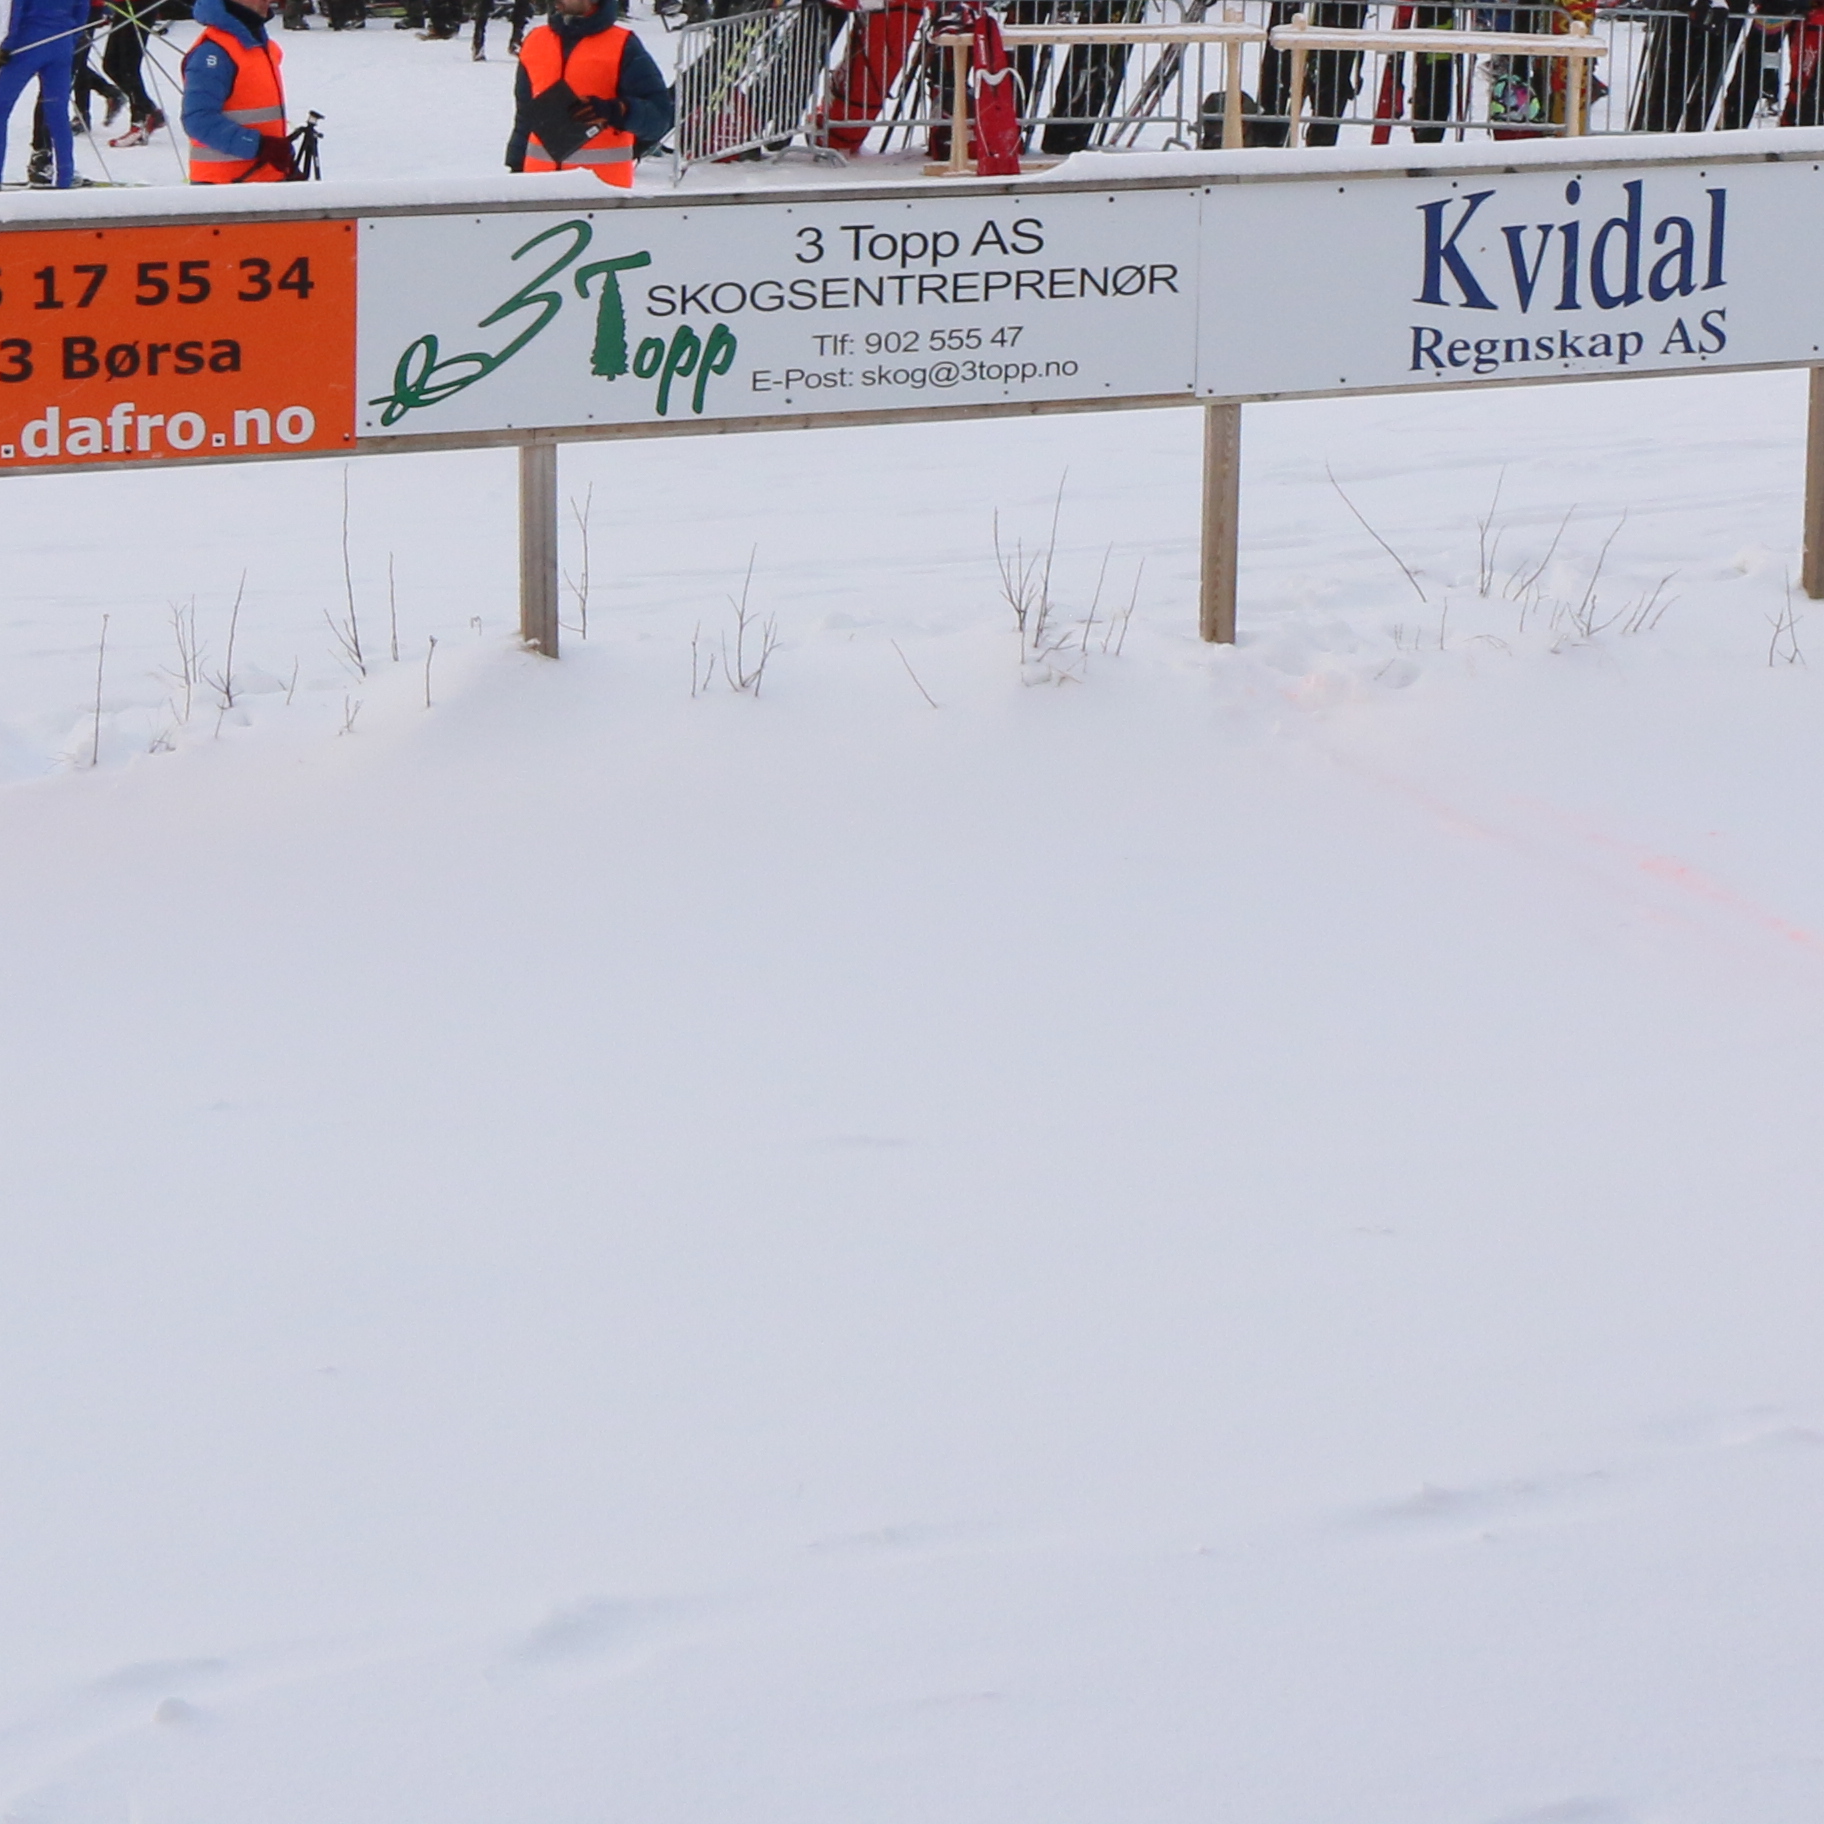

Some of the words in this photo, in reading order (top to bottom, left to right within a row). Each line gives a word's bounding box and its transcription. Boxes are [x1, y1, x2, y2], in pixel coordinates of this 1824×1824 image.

[795, 227, 824, 264] 3
[839, 223, 960, 269] Topp
[971, 218, 1045, 257] AS
[1412, 179, 1727, 314] Kvidal
[33, 264, 108, 310] 17
[135, 259, 212, 307] 55
[238, 256, 315, 303] 34
[646, 264, 1180, 317] SKOGSENTREPRENØR
[62, 335, 242, 384] Børsa
[812, 334, 855, 357] Tlf:
[864, 330, 920, 355] 902
[929, 328, 983, 352] 555
[990, 326, 1024, 348] 47
[1409, 325, 1644, 374] Regnskap
[1660, 308, 1728, 355] AS
[752, 367, 854, 392] E-Post:
[861, 359, 1079, 390] skog@3topp.no
